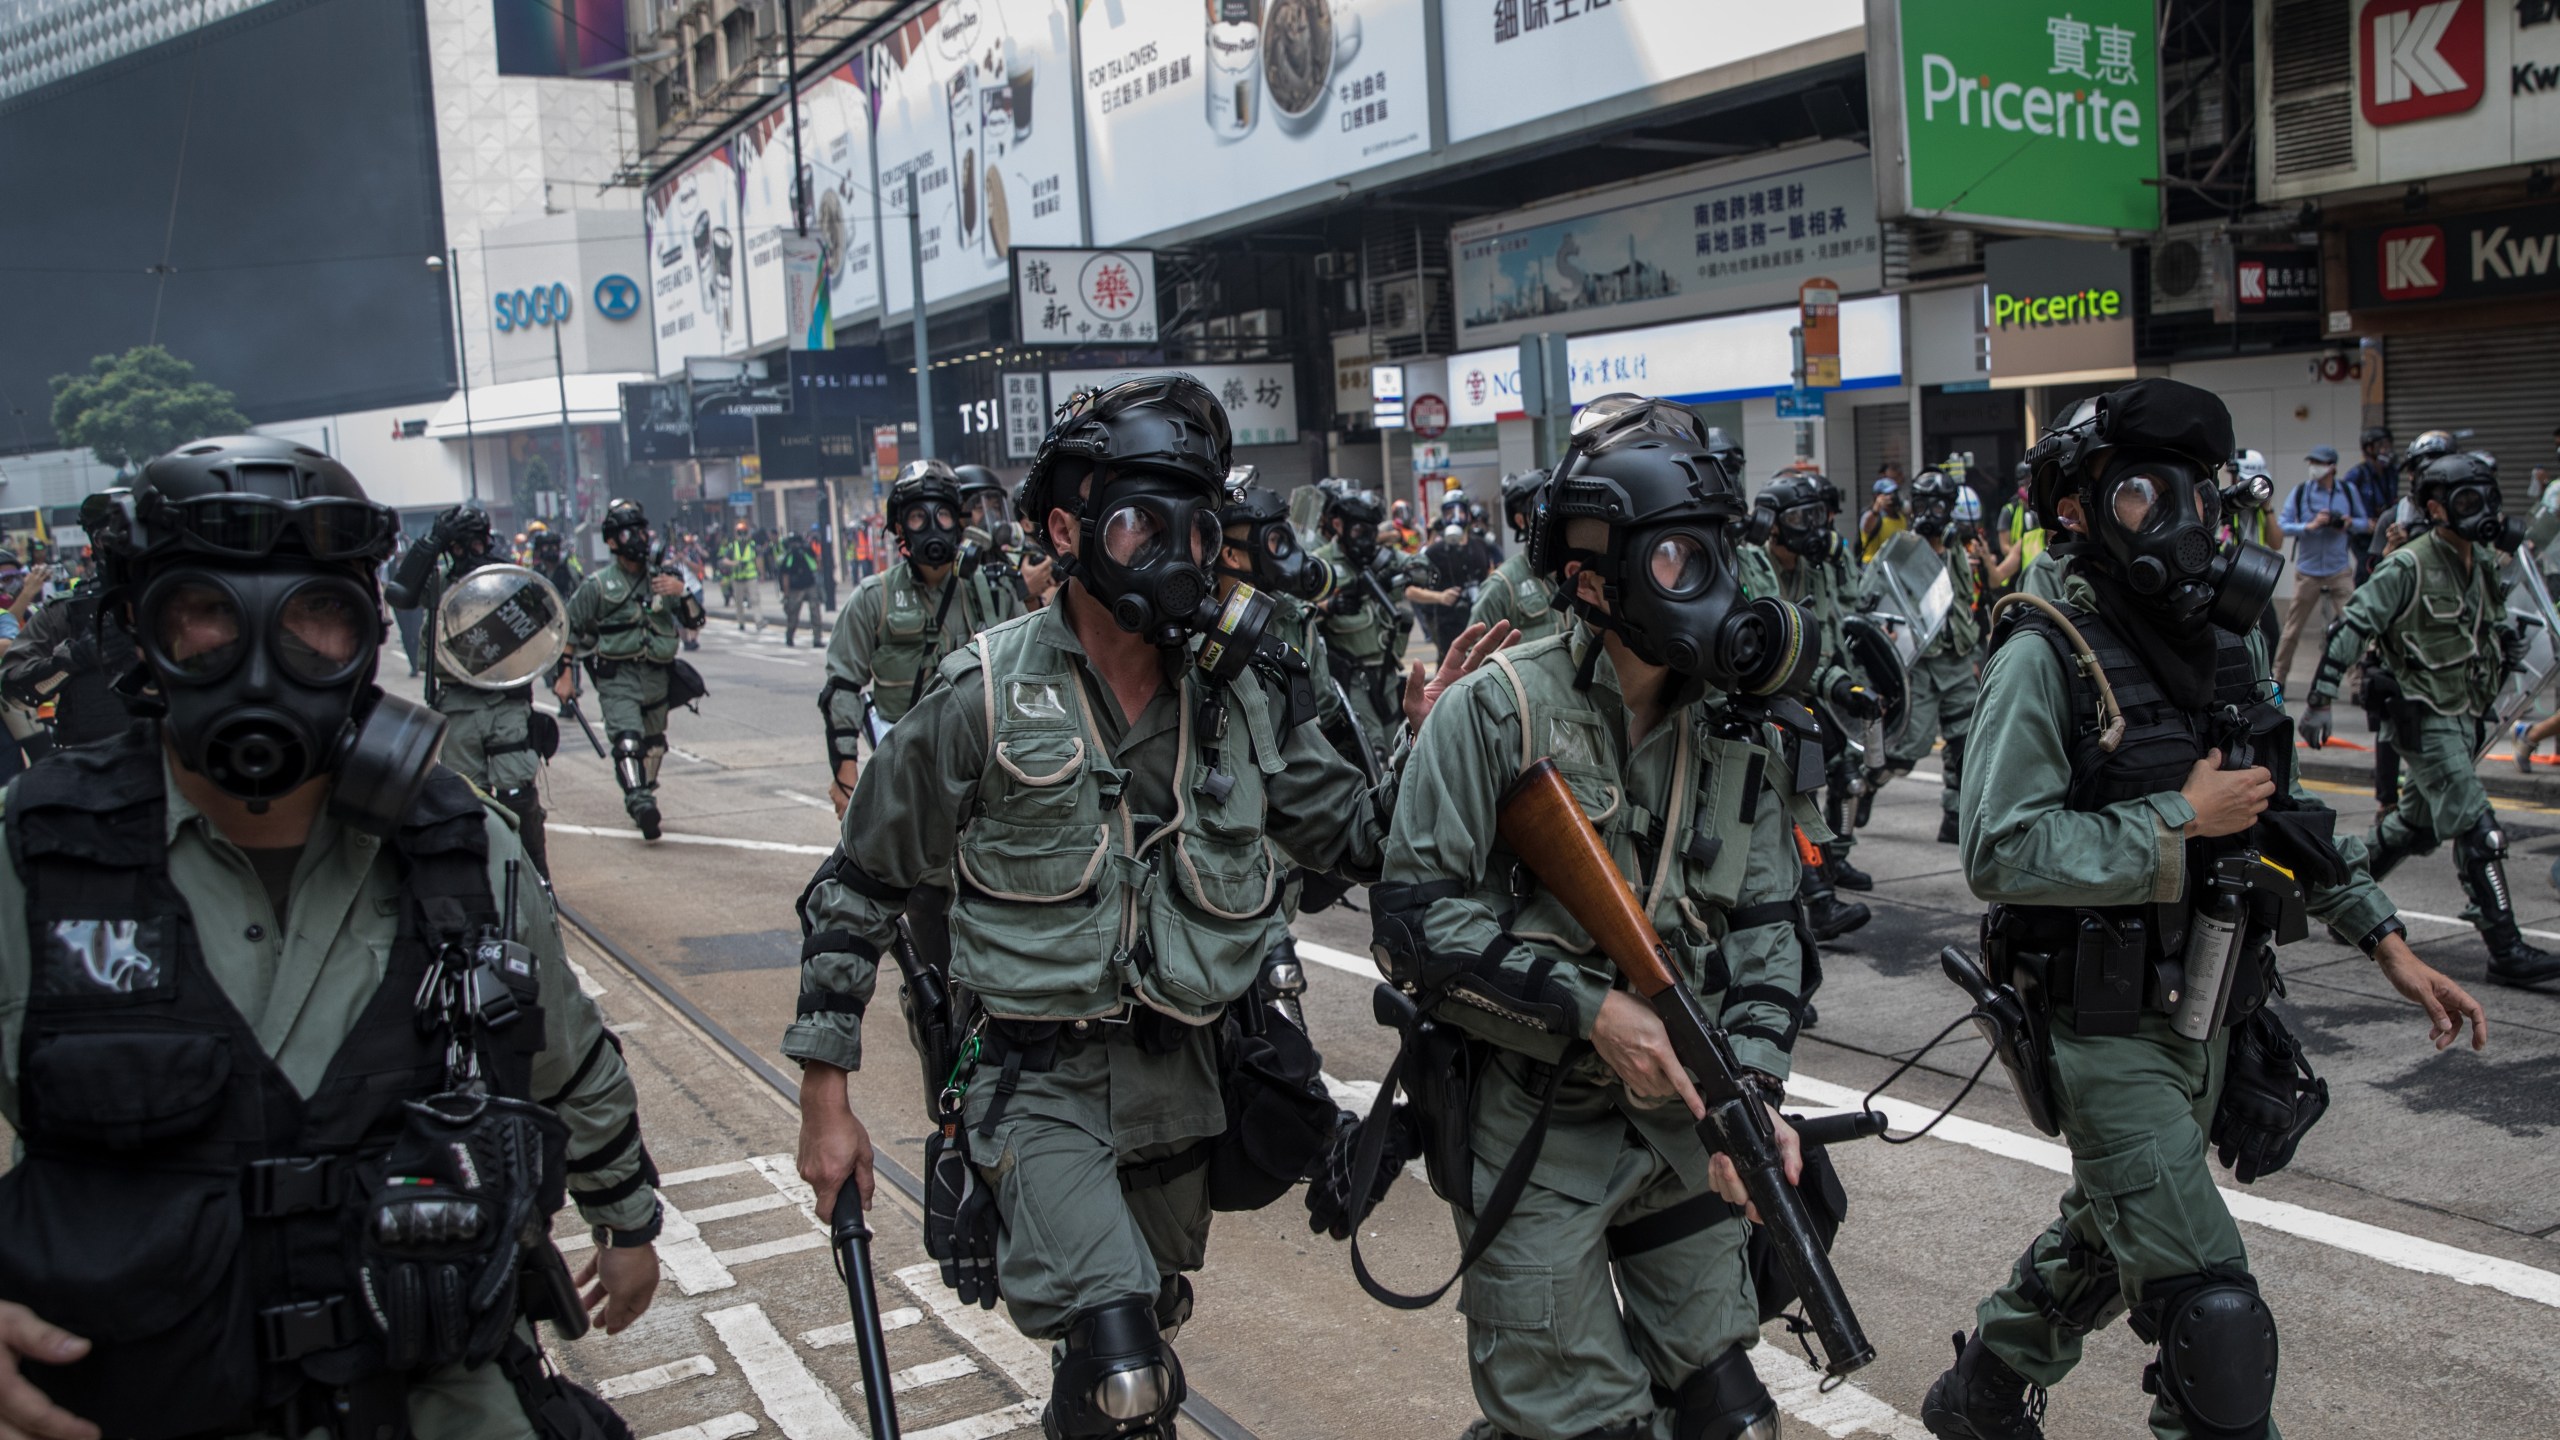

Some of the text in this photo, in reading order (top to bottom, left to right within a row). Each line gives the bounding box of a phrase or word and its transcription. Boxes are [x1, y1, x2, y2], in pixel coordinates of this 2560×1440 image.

[2046, 12, 2139, 86] 實惠
[1339, 71, 1386, 103] 牛油曲奇
[1921, 53, 2141, 147] Pricerite
[1341, 99, 1388, 133] 口感豐富
[1694, 182, 1805, 228] 南商跨境理財
[1695, 206, 1848, 257] 兩地服務一脈相承
[2471, 226, 2560, 282] Kw
[495, 281, 569, 333] SOGO
[1024, 259, 1072, 336] 龍新
[1093, 262, 1135, 310] 藥
[1995, 288, 2120, 327] Pricerite
[496, 599, 538, 640] POLICE
